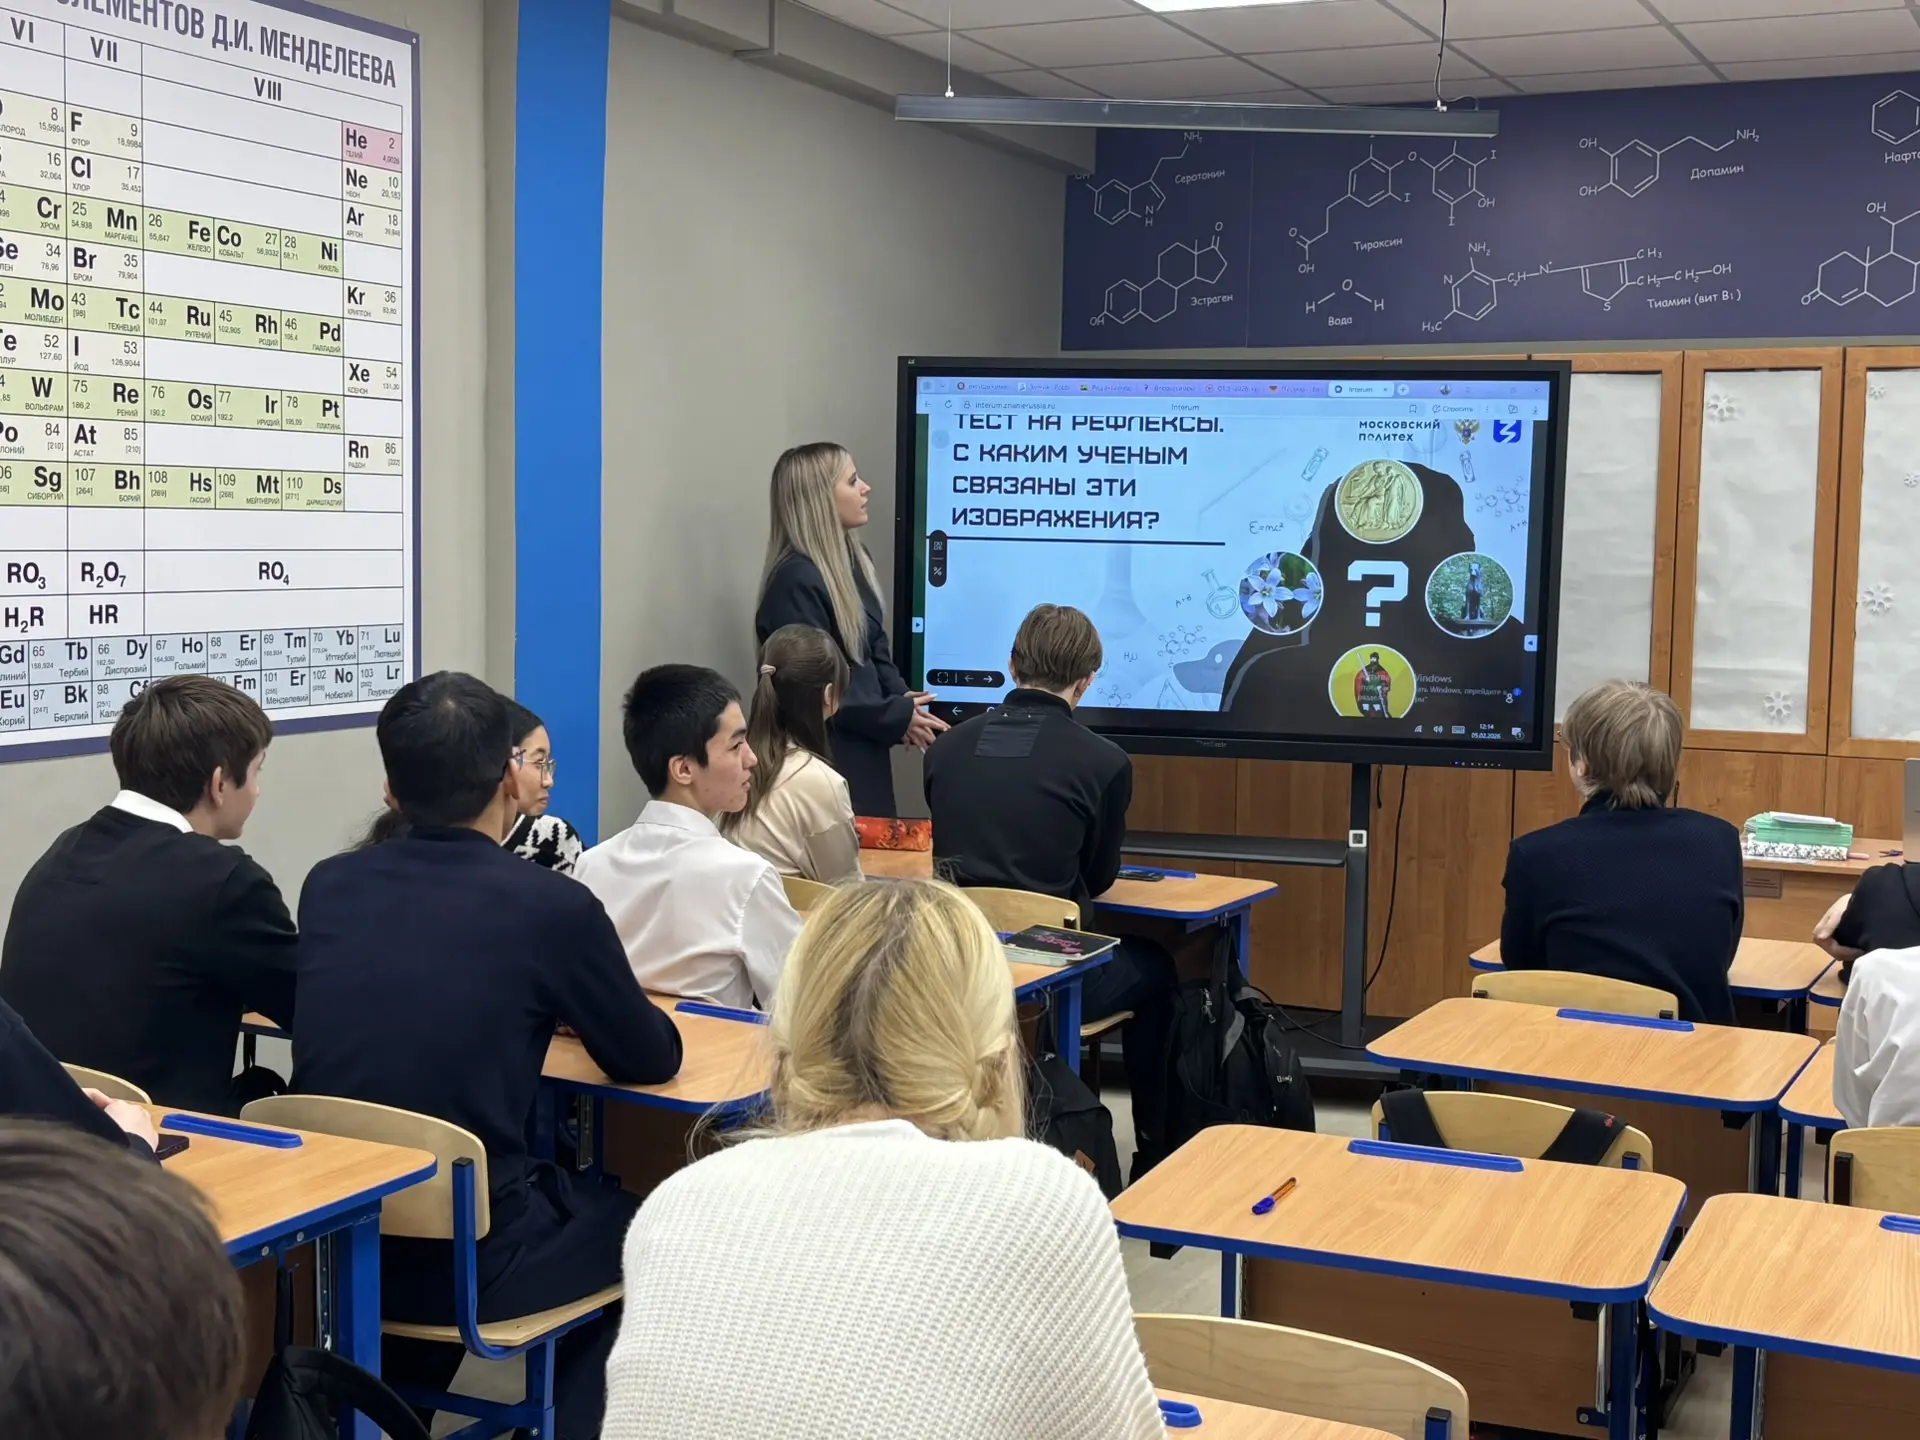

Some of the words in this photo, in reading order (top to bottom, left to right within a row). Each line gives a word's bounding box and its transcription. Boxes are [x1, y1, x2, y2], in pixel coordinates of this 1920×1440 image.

[10, 17, 34, 43] VI
[90, 36, 118, 62] VII
[212, 14, 253, 52] Д.И.
[260, 26, 396, 88] МЕНДЕЛЕЕВА
[253, 77, 282, 101] VIII
[51, 108, 58, 121] 8
[71, 112, 82, 132] F
[131, 124, 138, 137] 9
[346, 128, 368, 149] He
[48, 152, 61, 166] 16
[71, 156, 91, 179] Cl
[127, 166, 140, 180] 17
[346, 167, 368, 189] Ne
[1174, 169, 1226, 185] Серотонин
[1690, 164, 1744, 180] Допамин
[37, 196, 61, 219] Cr
[72, 201, 87, 216] 25
[346, 206, 364, 226] Ar
[1866, 202, 1887, 213] OH
[107, 207, 137, 231] Mn
[149, 213, 162, 228] 26
[188, 220, 211, 242] Fe
[217, 225, 242, 248] Co
[265, 232, 277, 246] 27
[46, 243, 61, 257] 34
[321, 241, 338, 262] Ni
[1354, 237, 1403, 252] Тироксин
[74, 247, 97, 269] Br
[124, 254, 138, 268] 35
[31, 287, 64, 311] Mo
[71, 292, 86, 306] 43
[348, 286, 366, 305] Kr
[1191, 294, 1233, 307] Эстраген
[1646, 296, 1691, 309] Тиамин
[1694, 292, 1718, 306] (вит
[25, 313, 64, 323] МОЛИБДЕН
[115, 297, 140, 320] Tc
[187, 305, 211, 327] Ru
[255, 313, 278, 335] Rh
[1328, 316, 1353, 326] Вода
[44, 334, 59, 348] 52
[320, 322, 341, 342] Pd
[124, 341, 138, 354] 53
[349, 362, 370, 382] Xe
[31, 376, 53, 398] W
[72, 379, 88, 393] 75
[113, 382, 139, 404] Re
[187, 388, 212, 410] Os
[322, 399, 340, 419] Pt
[45, 422, 60, 436] 84
[954, 414, 1018, 430] ТЕСТ
[1028, 415, 1062, 431] НА
[1071, 416, 1224, 433] РЕФЛЕКСЫ.
[74, 423, 97, 445] At
[124, 427, 138, 441] 85
[349, 440, 369, 459] Rn
[953, 443, 970, 462] С
[979, 444, 1067, 464] КАКИМ
[1077, 445, 1187, 466] УЧЕНЫМ
[34, 465, 62, 493] Sg
[75, 468, 96, 481] 107
[114, 469, 140, 490] Bh
[189, 472, 212, 492] Hs
[256, 474, 280, 494] Mt
[286, 477, 303, 490] 110
[323, 477, 342, 495] Ds
[952, 475, 1076, 496] СВЯЗАНЫ
[1086, 478, 1136, 497] ЭТИ
[952, 507, 1160, 530] ИЗОБРАЖЕНИЯ?
[89, 604, 118, 625] HR
[182, 637, 203, 653] Ho
[240, 634, 256, 651] Er
[284, 632, 307, 648] Tm
[336, 629, 354, 646] Yb
[384, 628, 401, 643] Lu
[65, 641, 88, 660] Tb
[126, 639, 148, 660] Dy
[290, 670, 306, 686] Er
[334, 668, 354, 684] No
[386, 665, 400, 680] Lr
[0, 689, 25, 709] Eu
[64, 684, 88, 704] Bk
